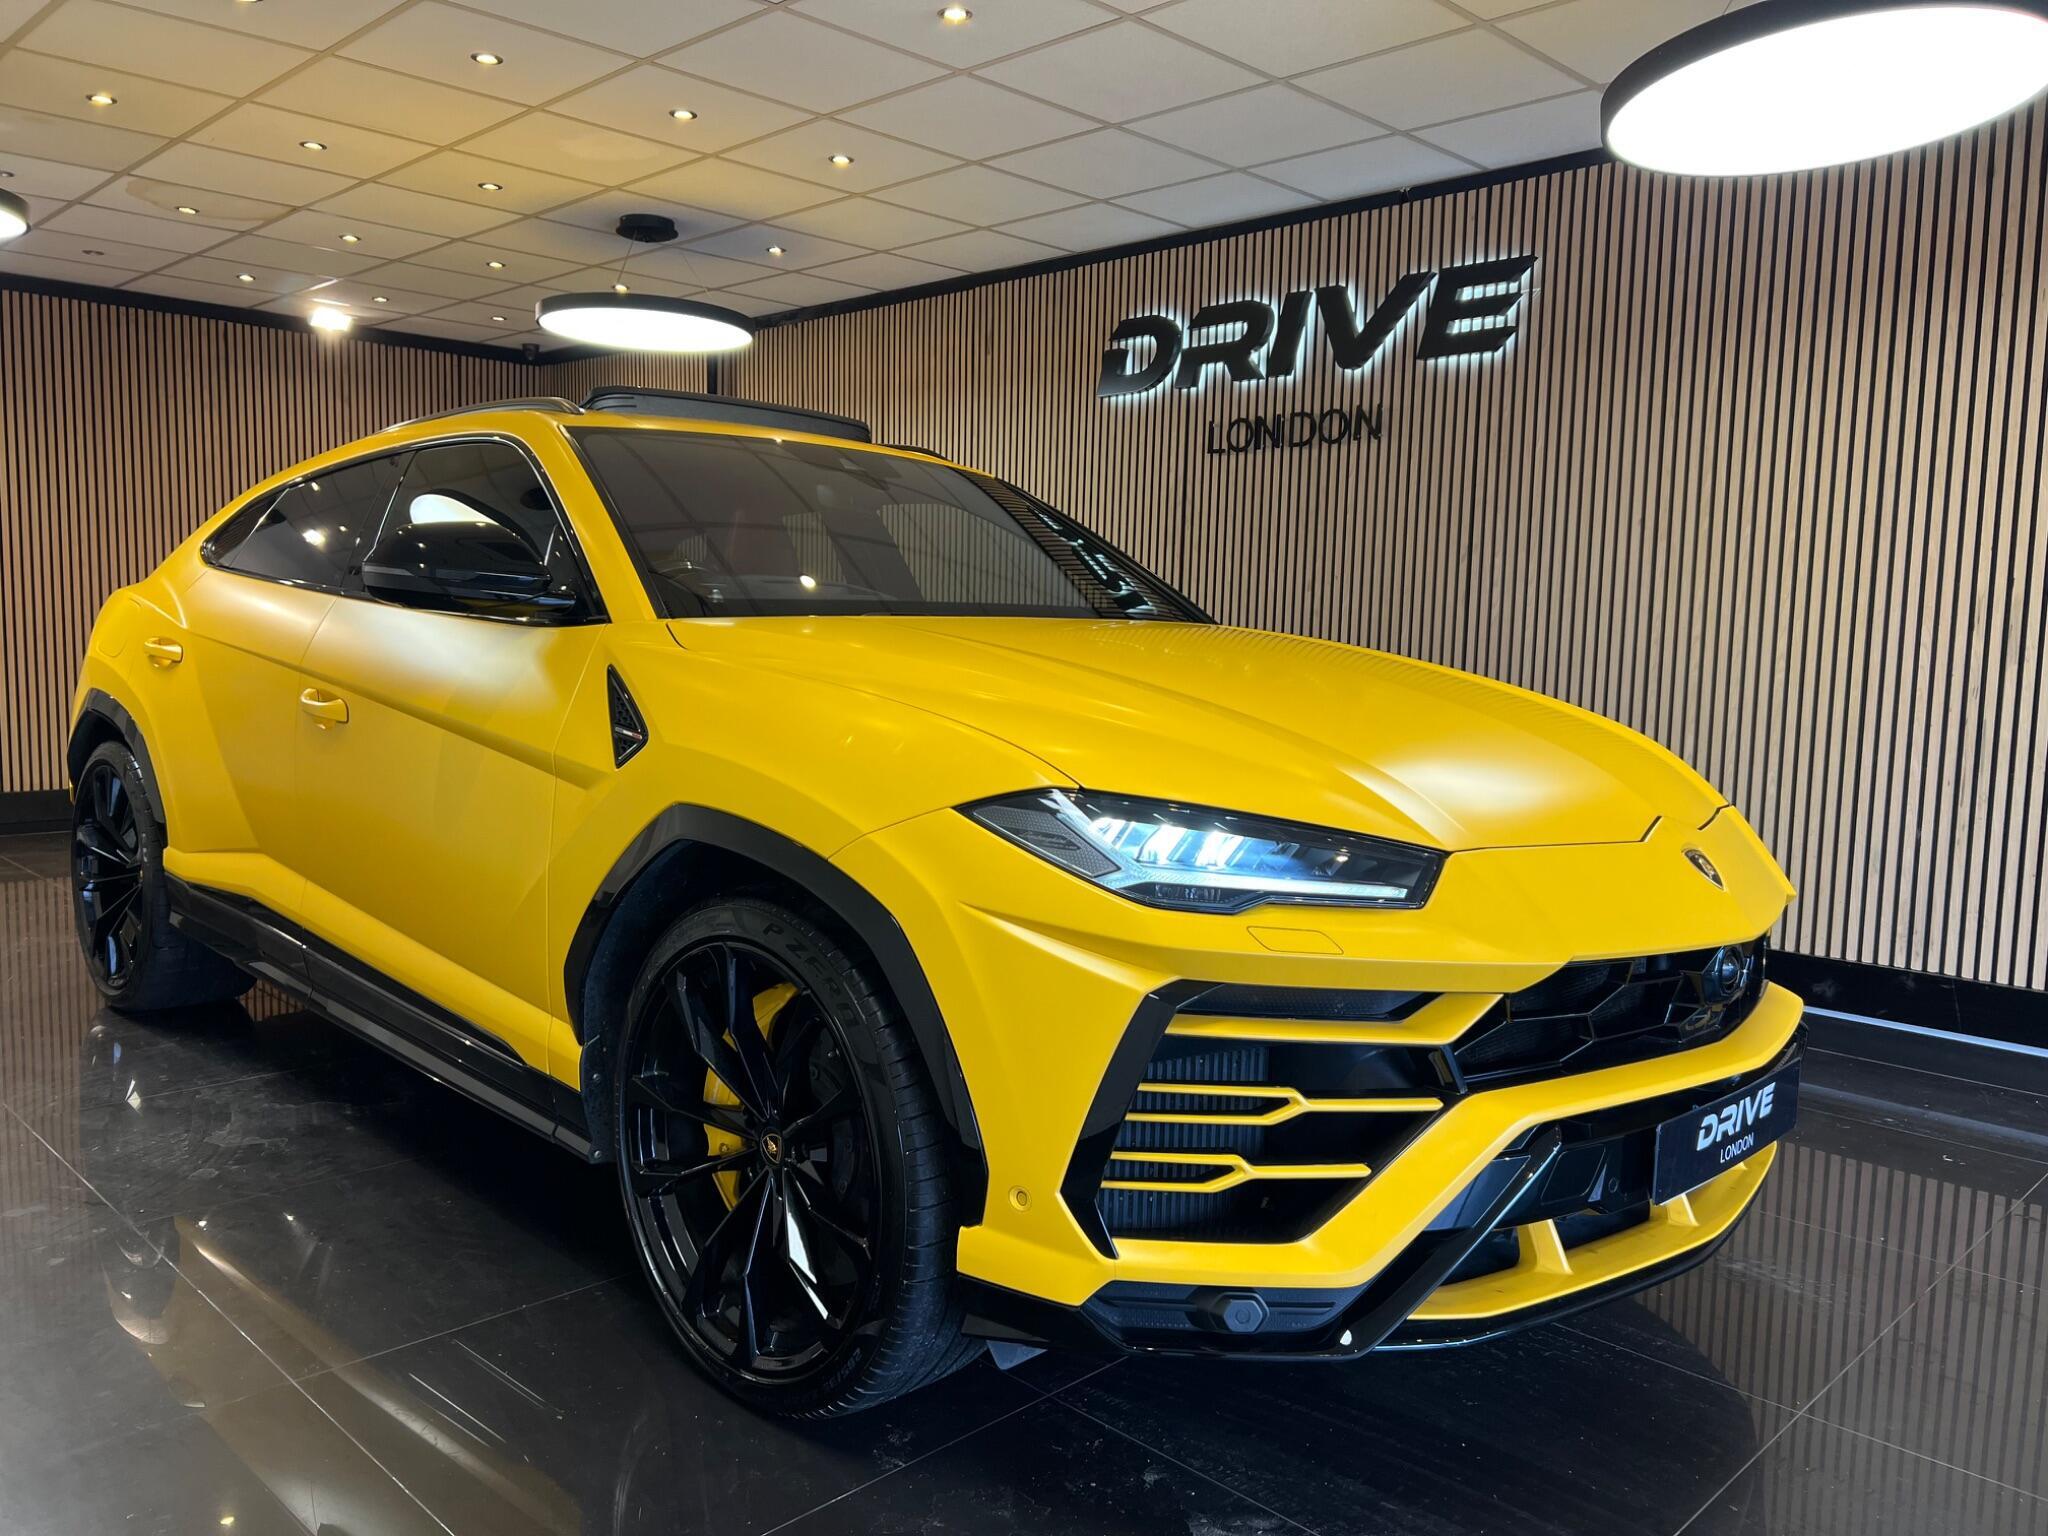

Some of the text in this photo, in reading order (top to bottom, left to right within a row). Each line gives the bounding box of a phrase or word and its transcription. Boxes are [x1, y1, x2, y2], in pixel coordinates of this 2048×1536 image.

[1097, 254, 1538, 398] DRIVE
[1207, 403, 1383, 455] LONDON
[1696, 1082, 1776, 1151] DRIVE
[1720, 1133, 1754, 1163] LONDON
